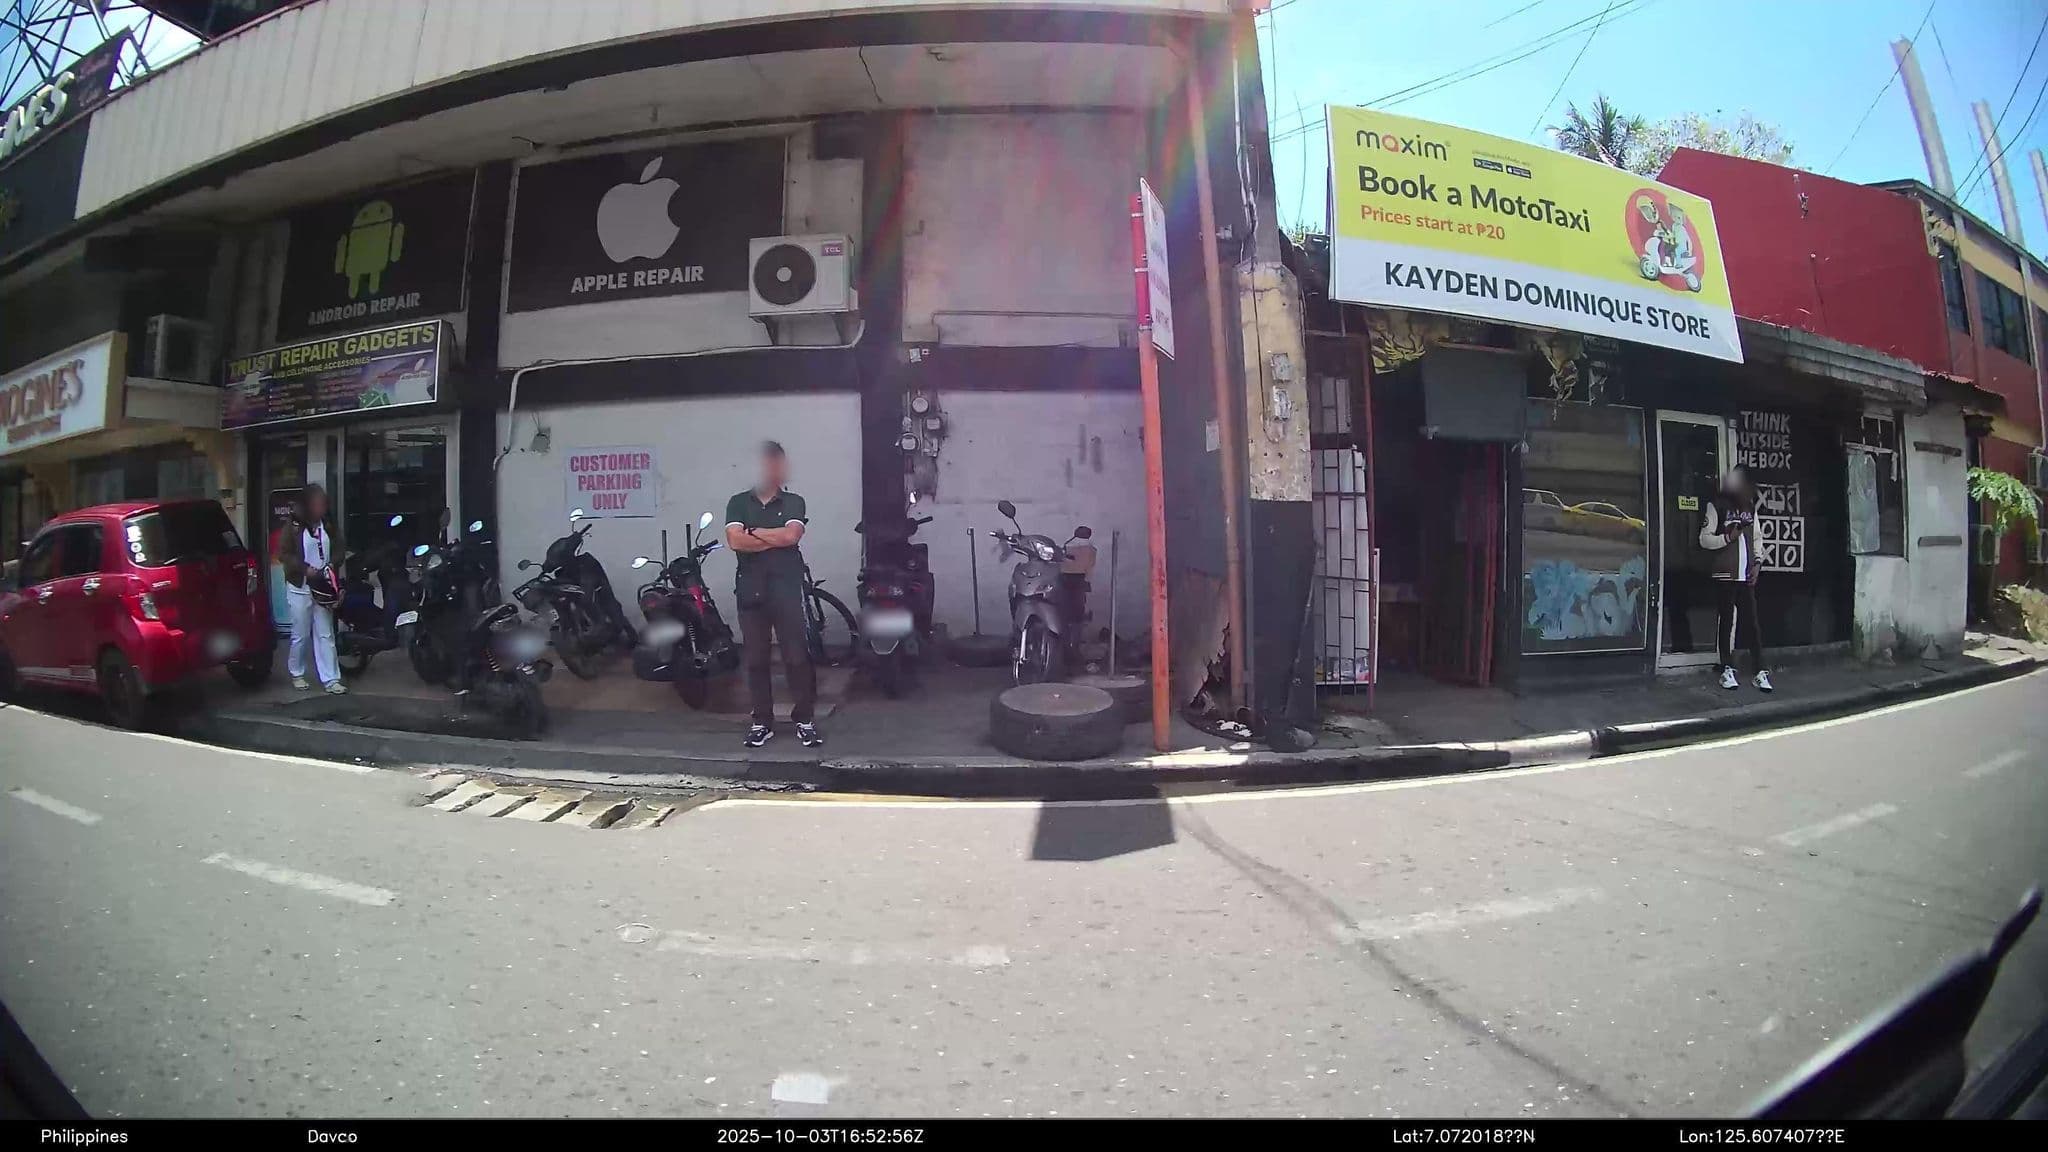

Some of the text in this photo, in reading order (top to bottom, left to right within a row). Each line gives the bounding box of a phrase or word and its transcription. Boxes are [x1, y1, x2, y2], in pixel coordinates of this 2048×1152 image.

[1357, 129, 1447, 162] maxim
[1358, 165, 1591, 233] Book a MotoTaxi
[1361, 204, 1411, 226] Prices
[1416, 215, 1454, 232] start
[1457, 221, 1473, 235] at
[570, 265, 704, 294] APPLE REPAIR
[308, 292, 420, 326] ANDROID REPAIR
[1385, 261, 1711, 339] KAYDEN DOMINIQUE STORE
[229, 324, 435, 376] TRUST REPAIR GADGETS
[1740, 411, 1791, 433] THINK
[1737, 432, 1791, 450] UTSIDE
[570, 453, 650, 472] CUSTOMER
[578, 473, 642, 491] PARKING
[592, 493, 628, 510] ONLY
